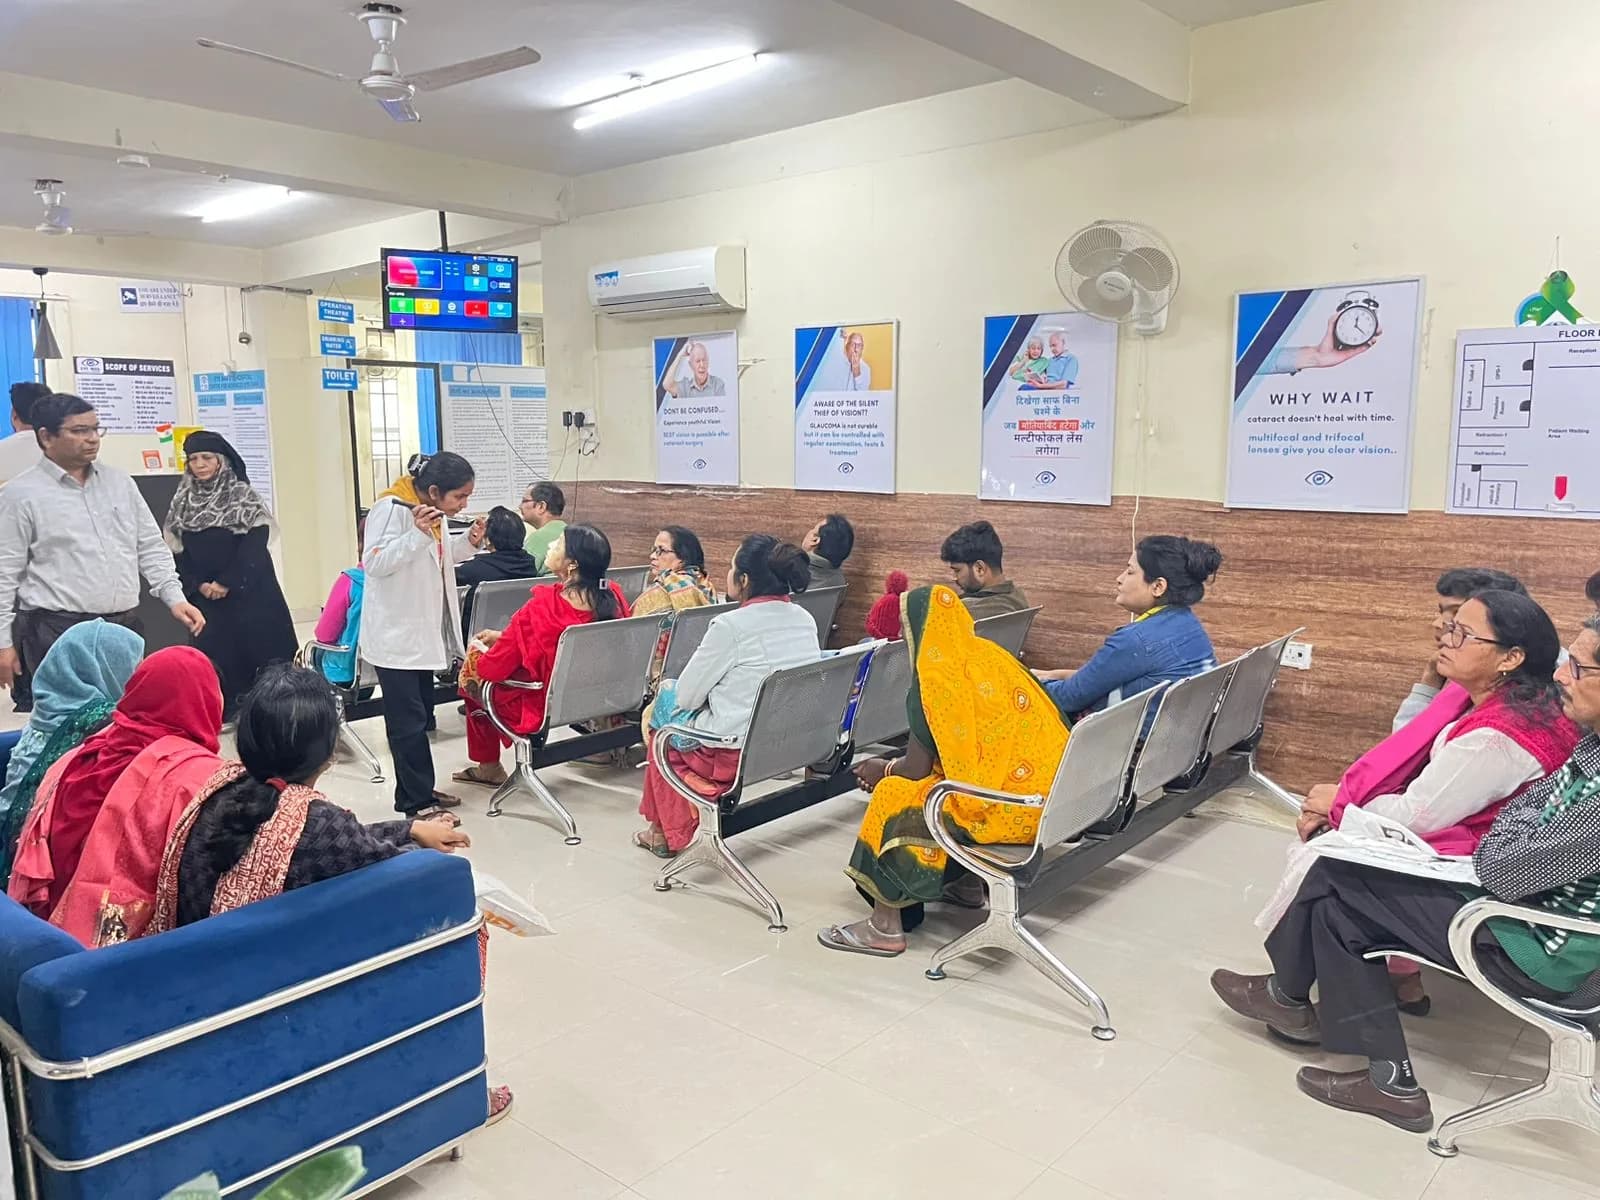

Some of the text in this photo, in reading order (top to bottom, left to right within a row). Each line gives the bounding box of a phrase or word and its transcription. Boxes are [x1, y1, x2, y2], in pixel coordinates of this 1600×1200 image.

[320, 301, 352, 311] OPERATION
[324, 308, 349, 317] THEATRE
[1558, 329, 1596, 338] FLOOR
[105, 363, 128, 371] SCOPE
[130, 364, 138, 372] OF
[140, 364, 170, 373] SERVICES
[324, 370, 355, 381] TOILET
[1016, 395, 1040, 405] दिखेगा
[1270, 391, 1374, 405] WHY WAIT
[814, 400, 834, 408] AWARE
[688, 418, 706, 426] youthful
[1248, 412, 1394, 422] cataract doesn't heal with time.
[1014, 432, 1063, 442] मल्टीफोकल
[1248, 432, 1364, 442] multifocal and trifocal
[1035, 444, 1060, 456] लगेगा
[1248, 445, 1397, 456] lenses give you clear vision..
